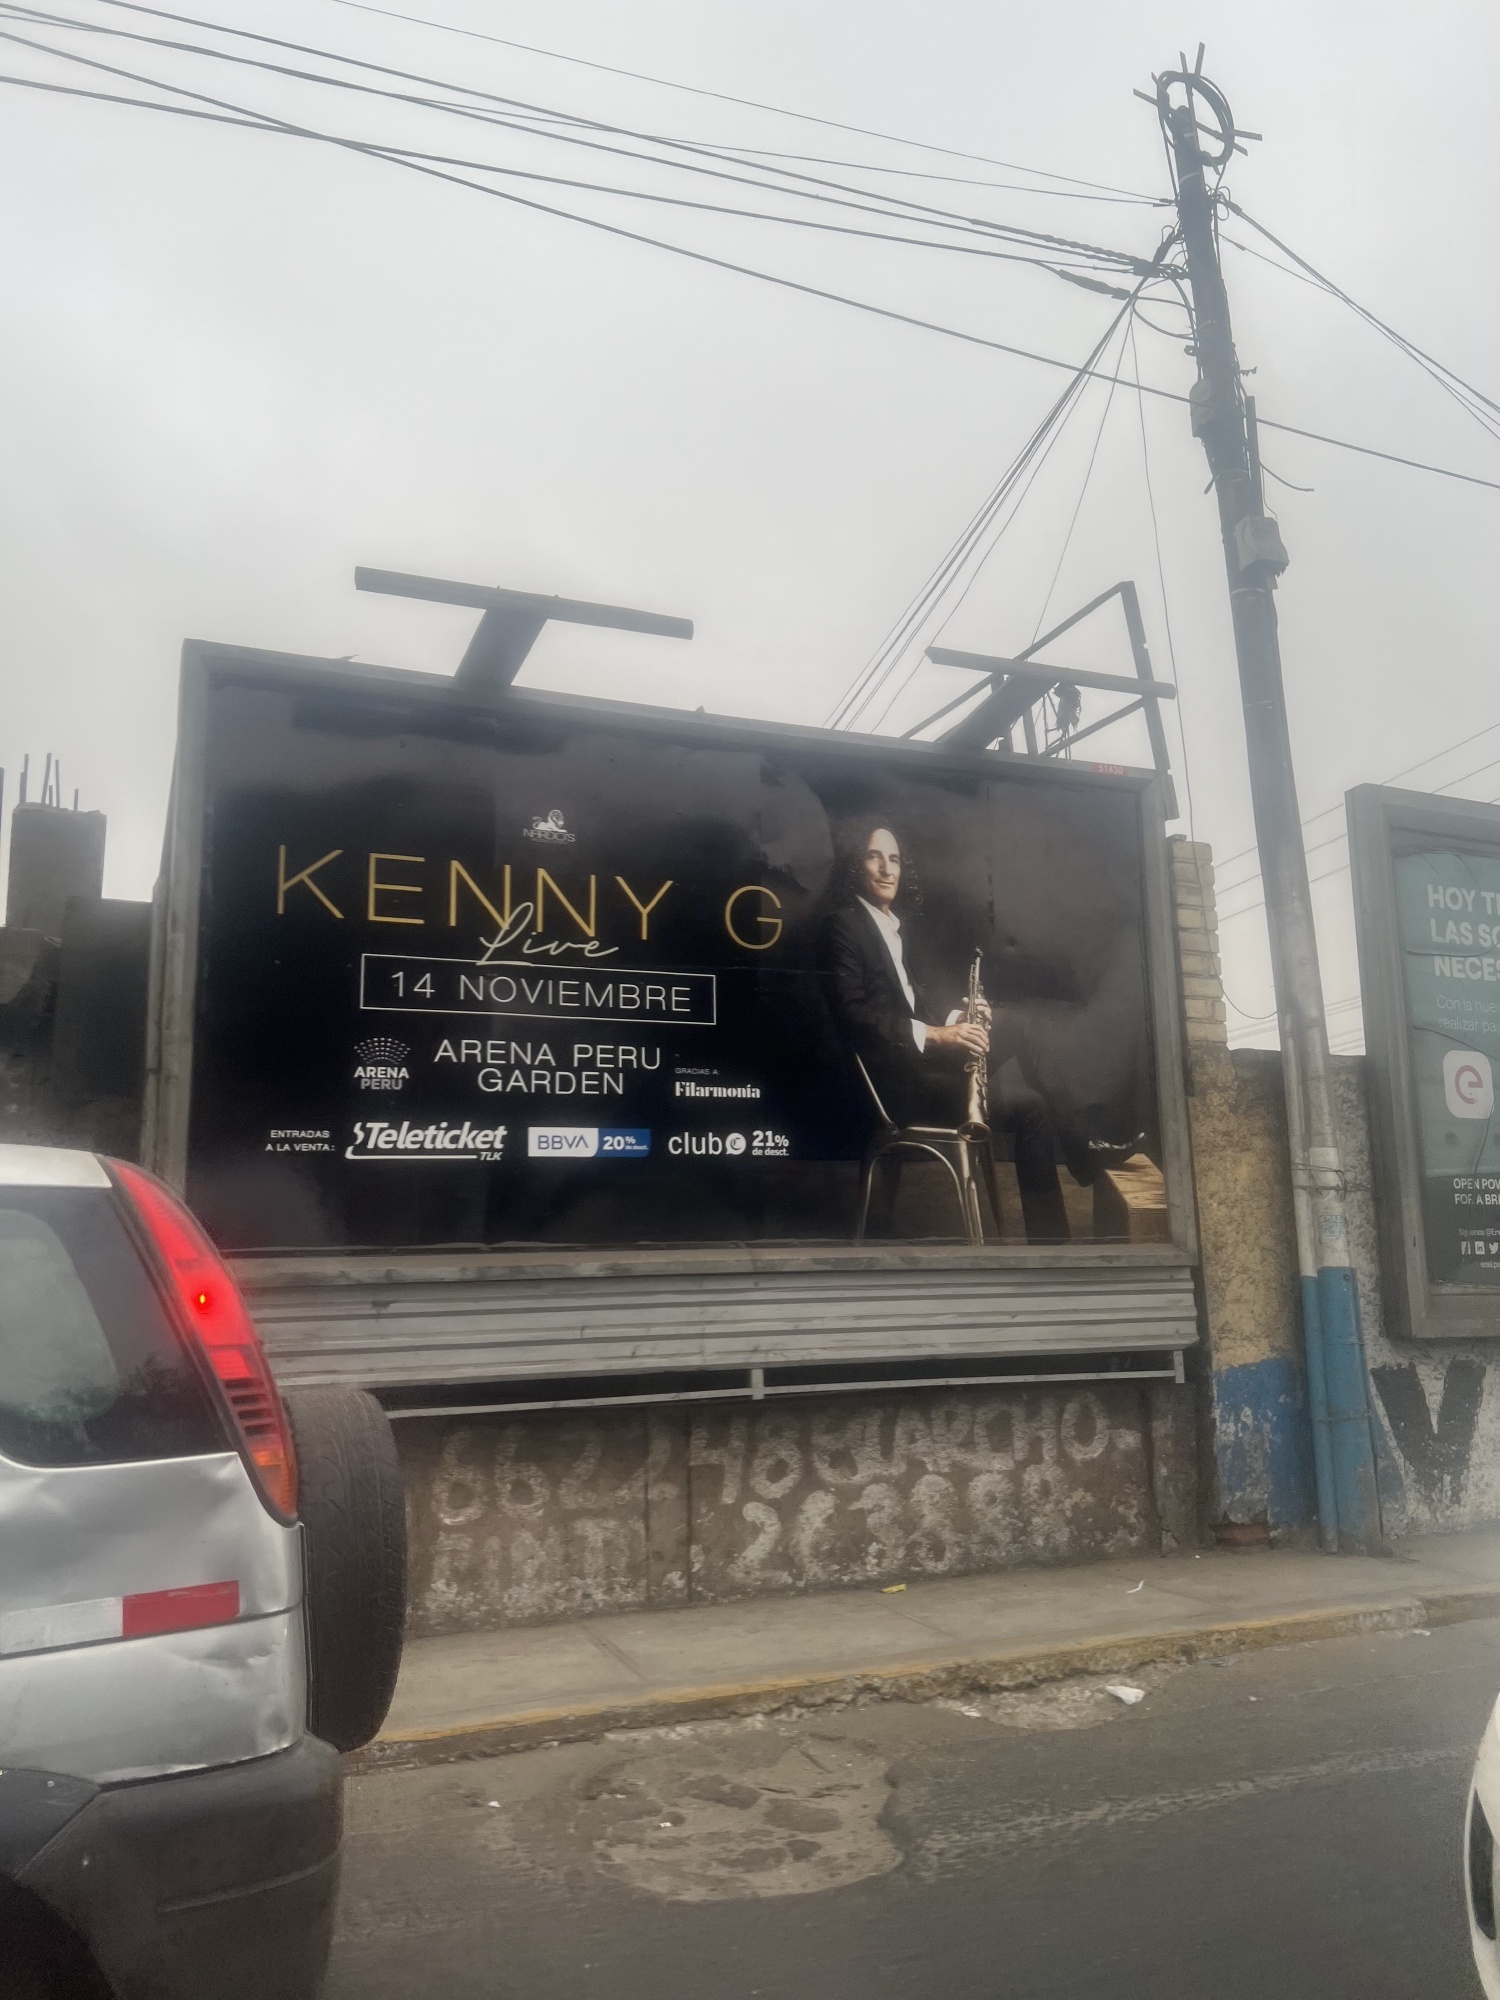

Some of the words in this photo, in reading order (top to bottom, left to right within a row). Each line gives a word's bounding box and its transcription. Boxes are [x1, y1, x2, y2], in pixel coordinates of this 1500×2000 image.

[277, 844, 675, 941] KENNY
[725, 885, 783, 950] G
[1427, 884, 1476, 912] HOY
[476, 901, 619, 966] Live
[1430, 918, 1473, 946] LAS
[391, 971, 436, 999] 14
[460, 973, 692, 1012] NOVIEMBRE
[1436, 995, 1460, 1010] Con
[1439, 1016, 1480, 1031] realizar
[434, 1039, 556, 1066] ARENA
[573, 1044, 661, 1070] PERU
[353, 1066, 410, 1079] ARENA
[361, 1078, 403, 1090] PERU
[478, 1067, 624, 1095] GARDEN
[270, 1130, 330, 1138] ENTRADAS
[366, 1121, 508, 1149] Teleticket
[752, 1130, 789, 1147] 21%
[294, 1143, 335, 1152] VENTA:
[538, 1135, 589, 1149] BBVA
[603, 1136, 636, 1150] 20%
[668, 1132, 722, 1155] club
[479, 1151, 504, 1161] TLK
[752, 1148, 763, 1156] de
[764, 1148, 789, 1156] desct.
[1453, 1178, 1480, 1190] OPEN
